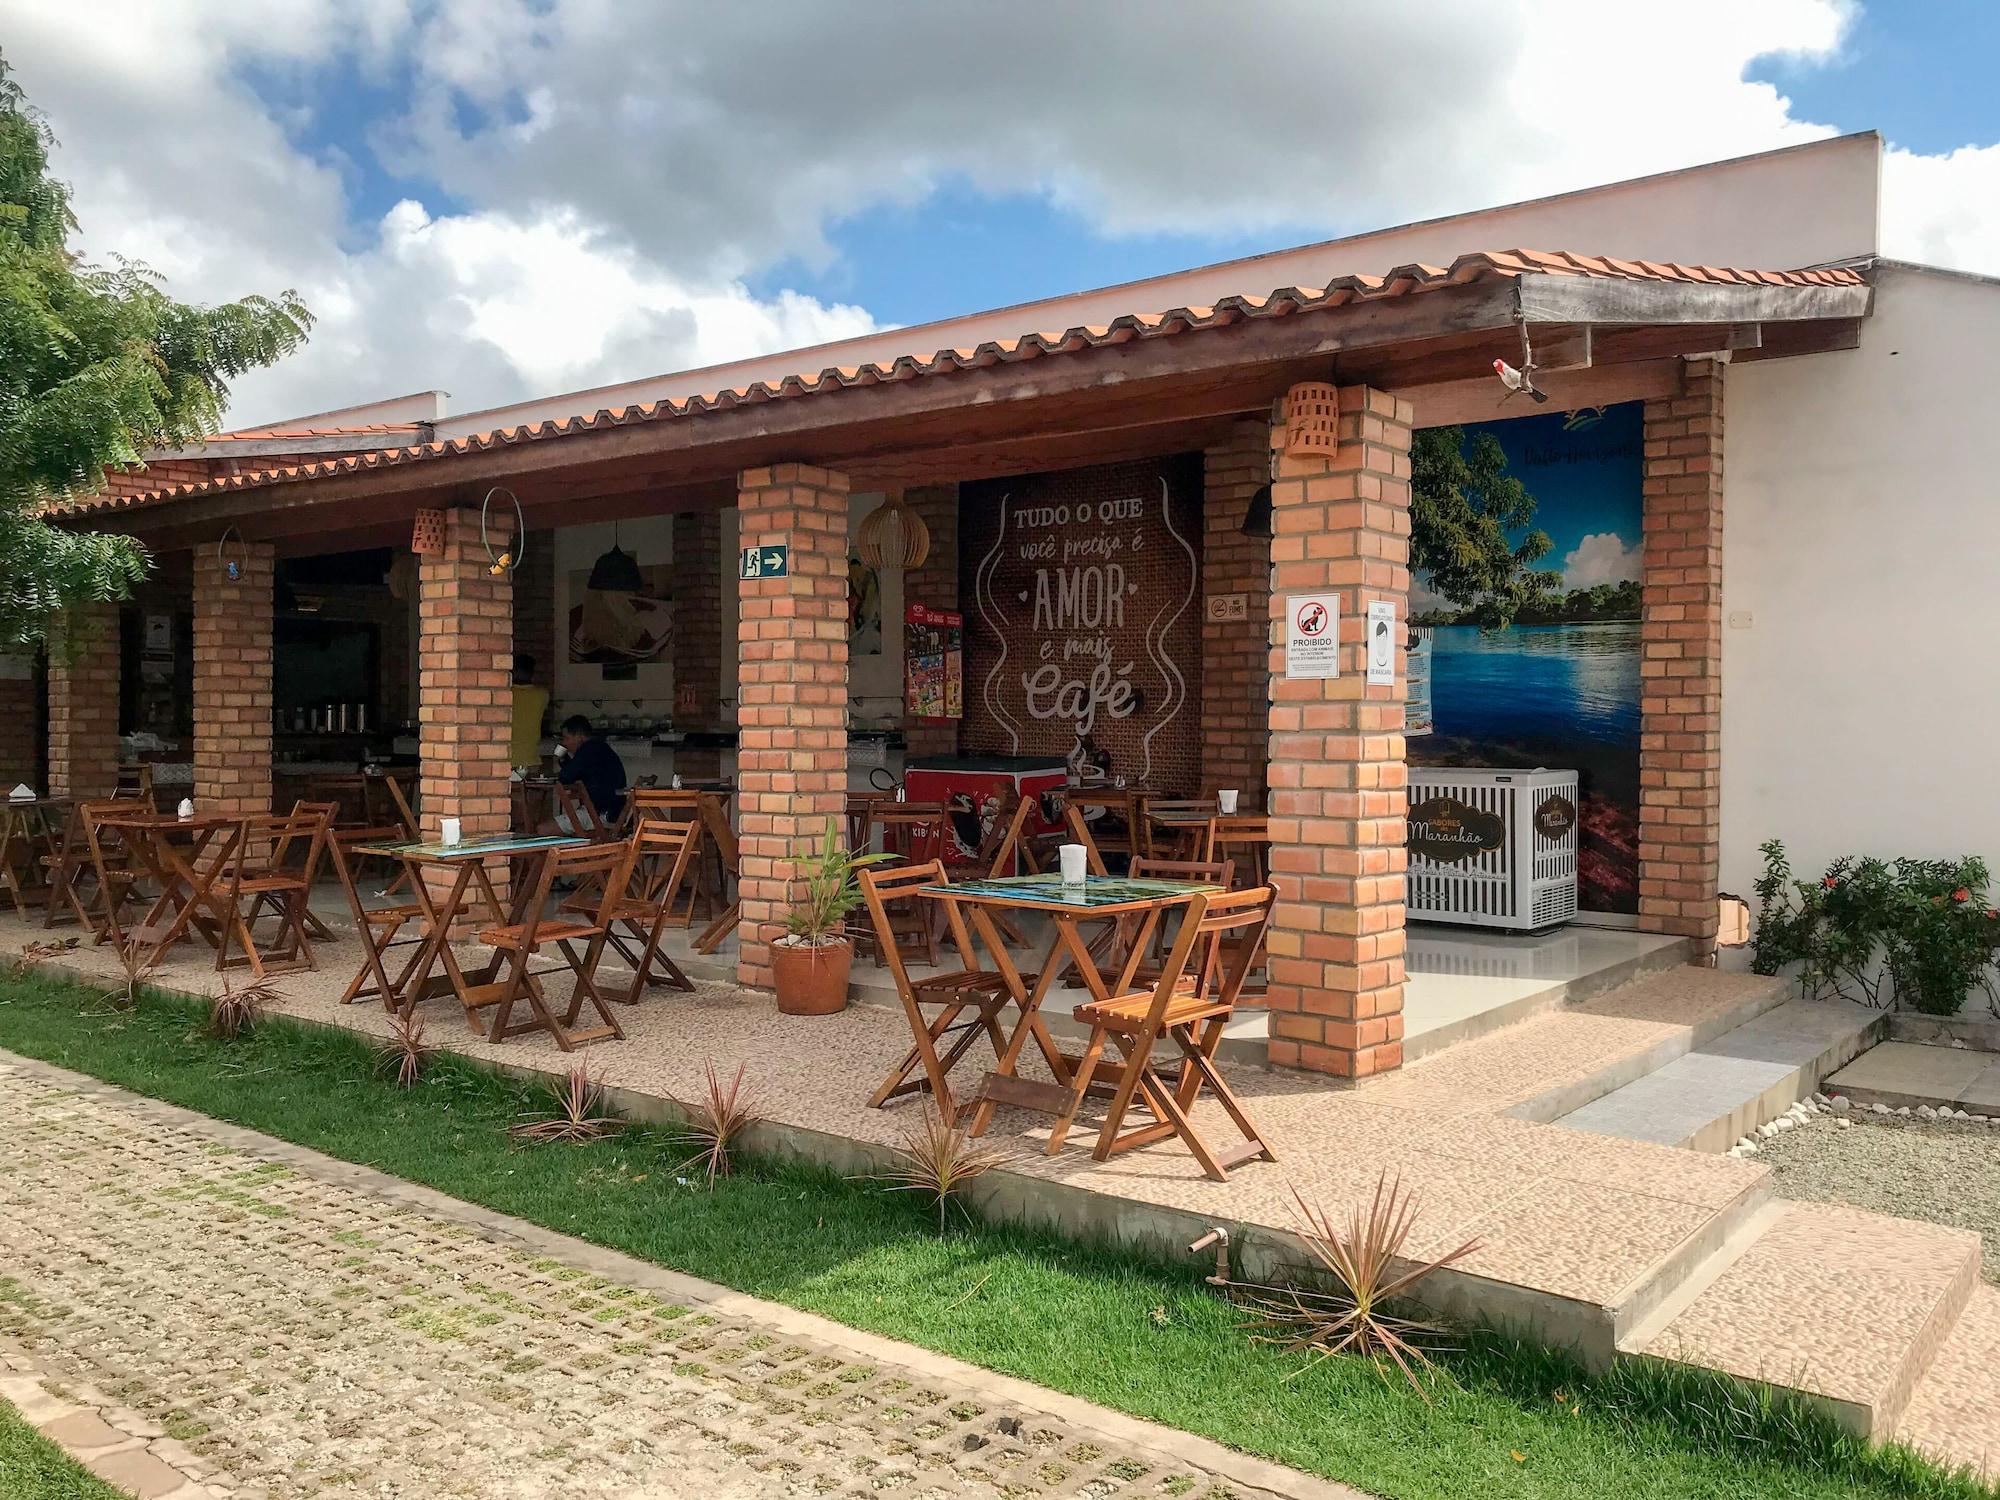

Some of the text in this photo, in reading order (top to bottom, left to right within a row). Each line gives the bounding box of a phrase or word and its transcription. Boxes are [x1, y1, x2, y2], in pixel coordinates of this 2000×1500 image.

[1014, 498, 1144, 529] TUDO O QUE
[1020, 527, 1145, 564] você precisa é
[1033, 563, 1125, 631] AMOR
[1040, 630, 1115, 664] e mais
[1293, 638, 1332, 647] PROIBIDO
[1022, 660, 1137, 735] Café
[912, 827, 940, 838] KIBN
[1407, 820, 1483, 844] Maranhão
[1428, 818, 1461, 827] SABORES
